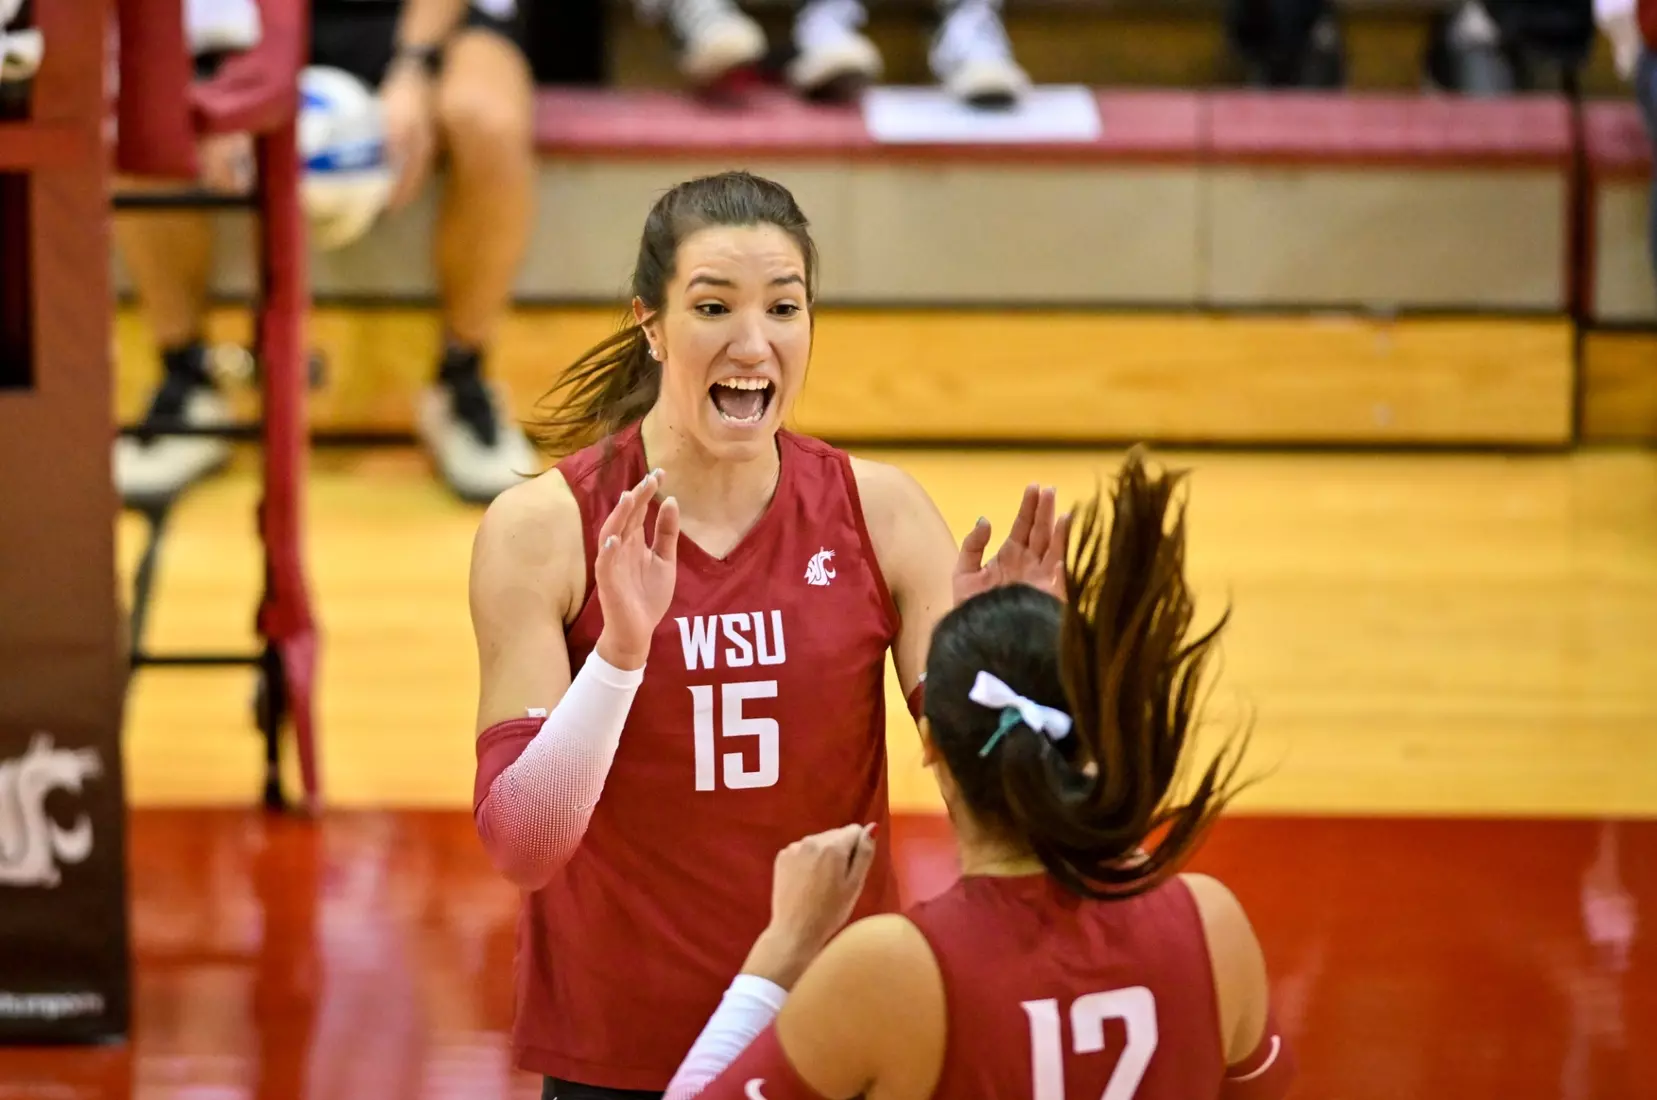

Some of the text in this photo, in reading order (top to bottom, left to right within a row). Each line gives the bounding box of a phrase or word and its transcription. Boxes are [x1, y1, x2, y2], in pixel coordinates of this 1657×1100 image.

[673, 609, 787, 671] WSU
[686, 680, 780, 792] 15
[1019, 985, 1160, 1100] 12
